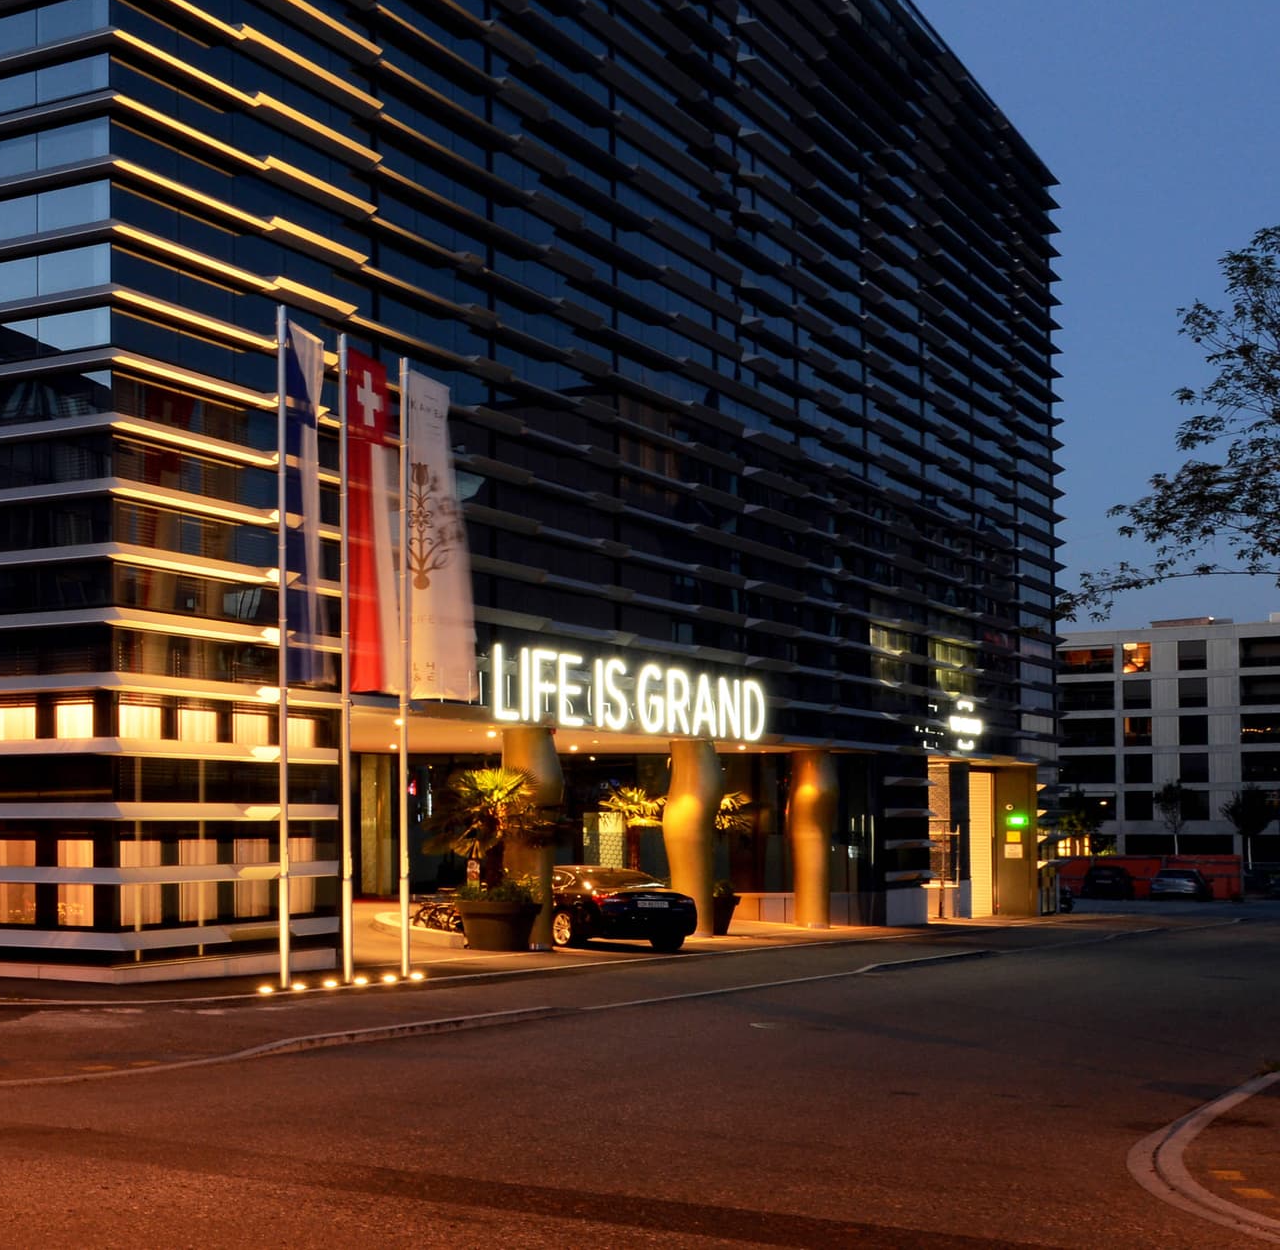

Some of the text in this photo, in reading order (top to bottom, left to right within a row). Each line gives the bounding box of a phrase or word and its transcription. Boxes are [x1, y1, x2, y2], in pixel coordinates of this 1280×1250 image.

[493, 643, 766, 741] LIFE IS GRAND
